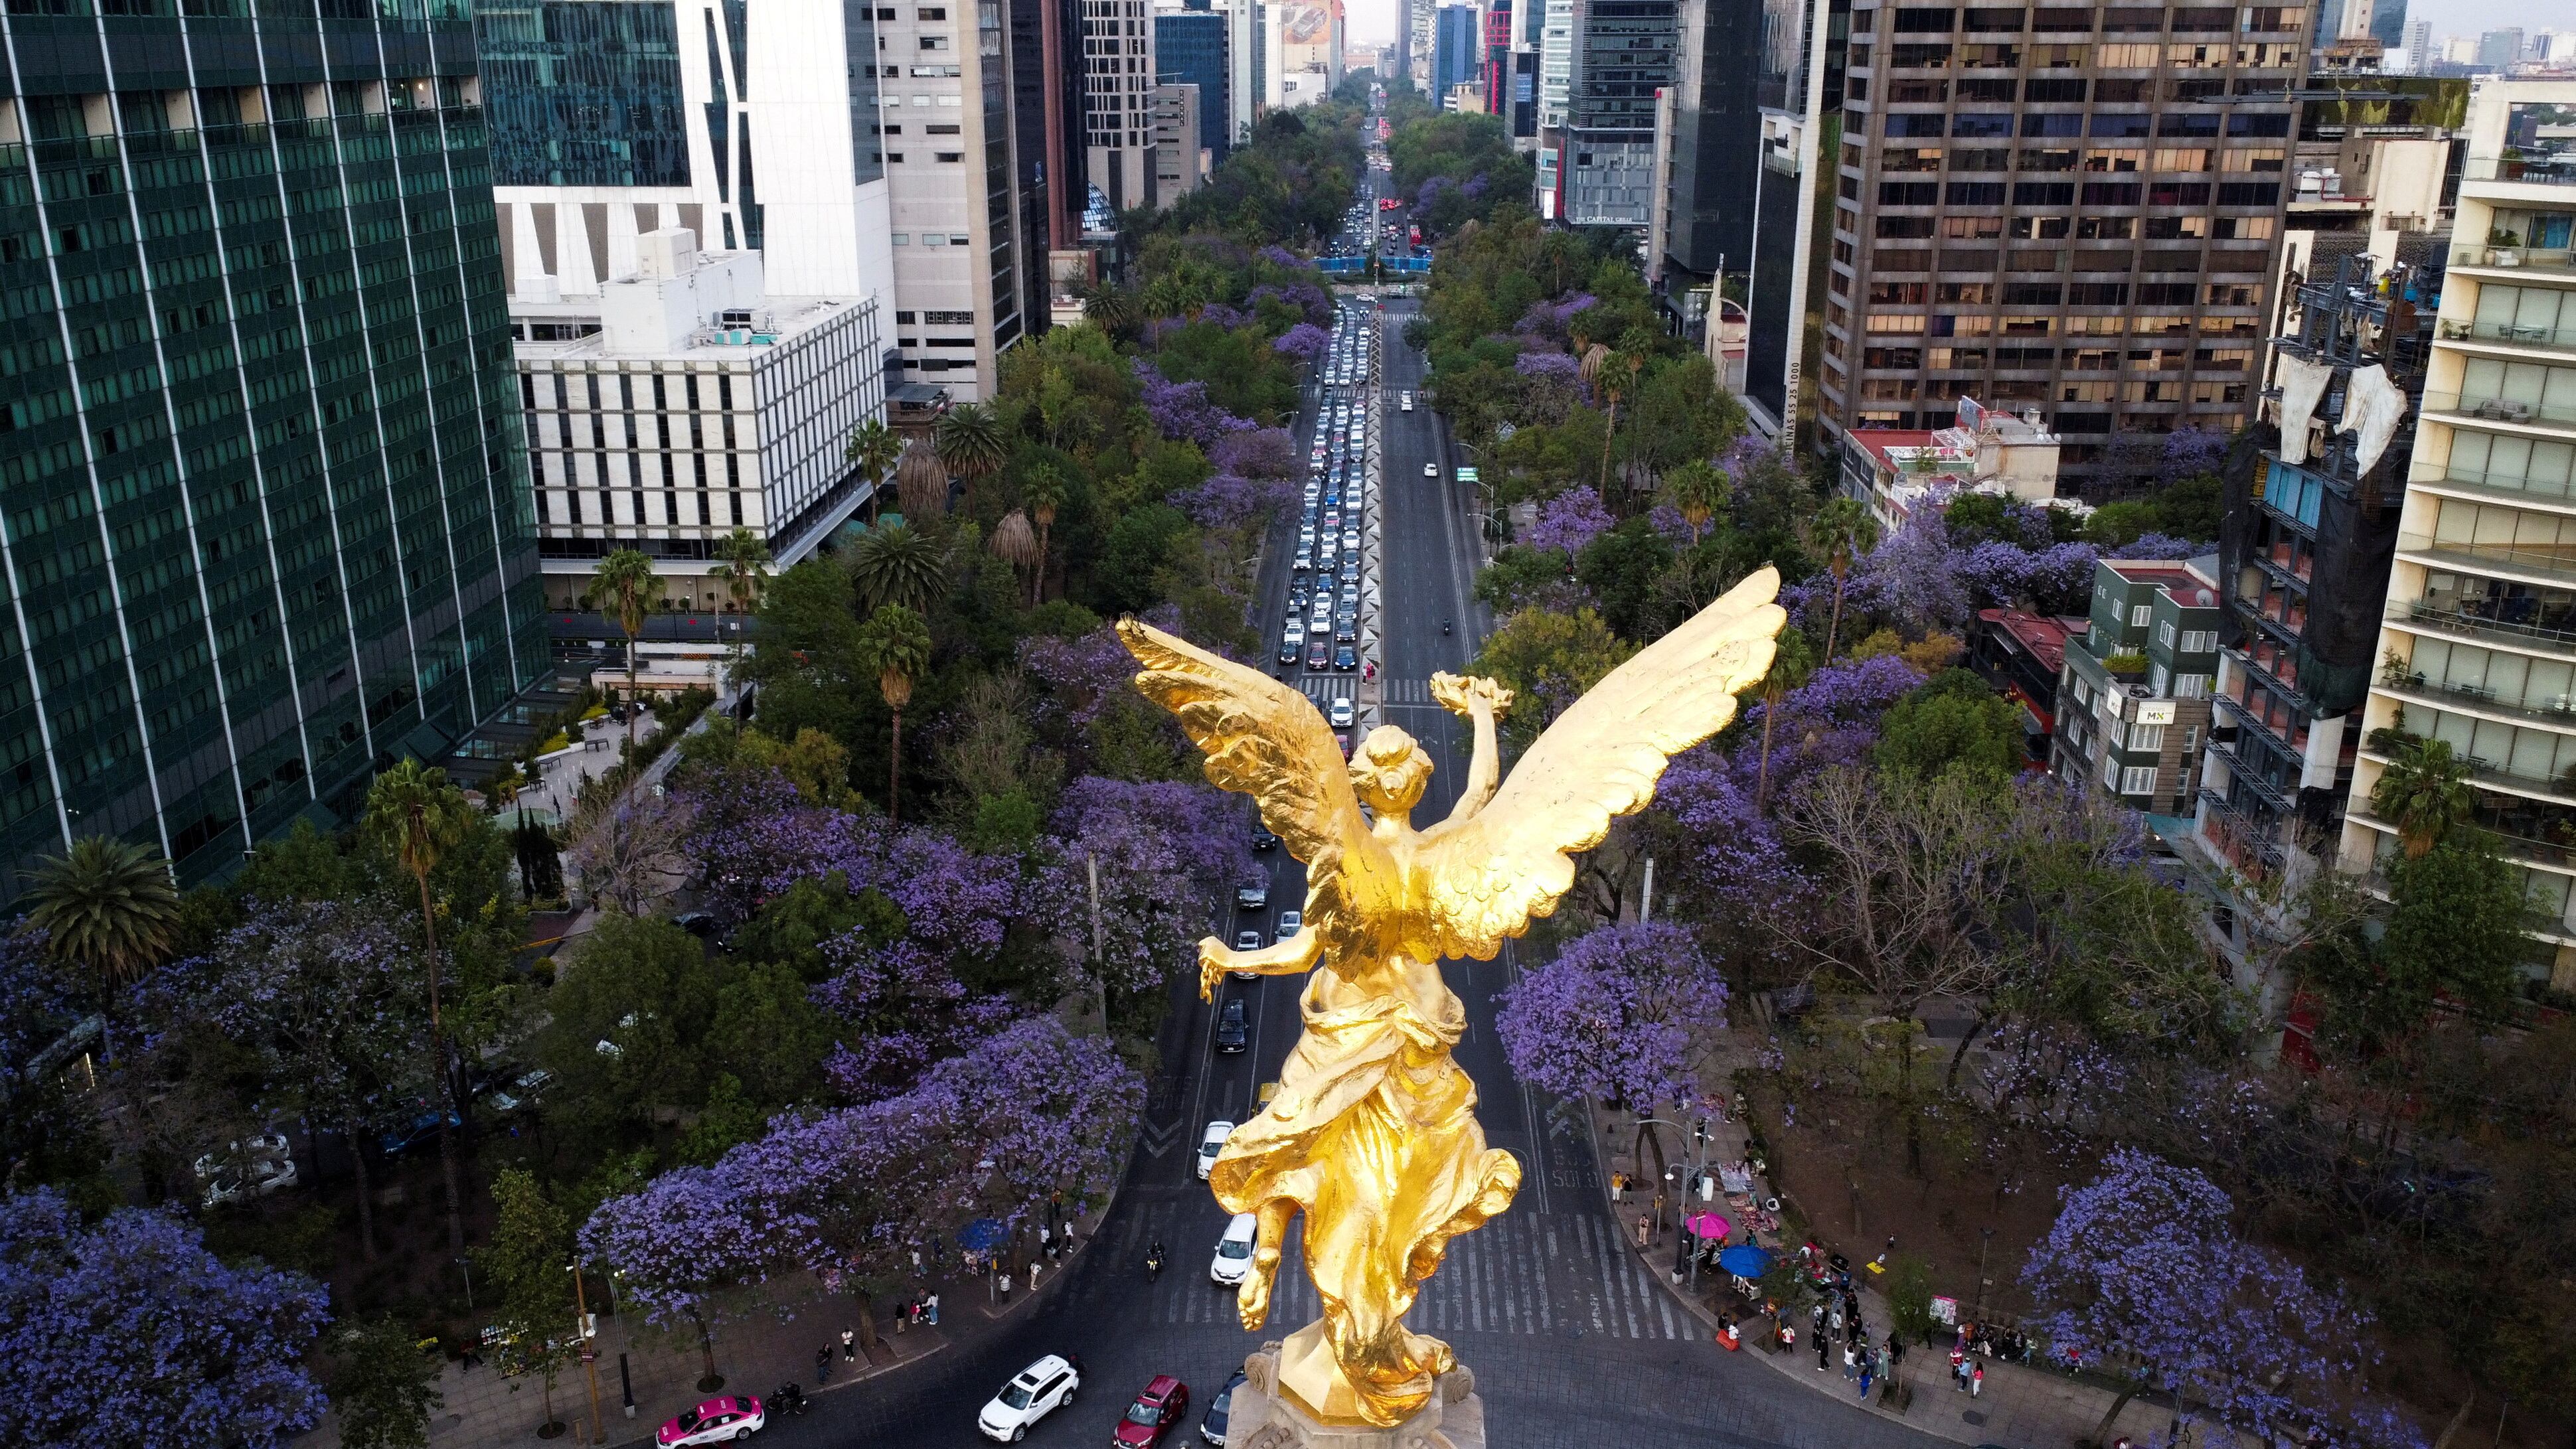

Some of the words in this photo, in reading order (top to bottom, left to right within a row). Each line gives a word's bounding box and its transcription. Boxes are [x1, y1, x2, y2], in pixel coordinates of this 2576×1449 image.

[1790, 362, 1800, 384] 1000
[1789, 389, 1797, 399] 25
[1788, 404, 1797, 414] 55
[1783, 419, 1795, 463] OFICINAS
